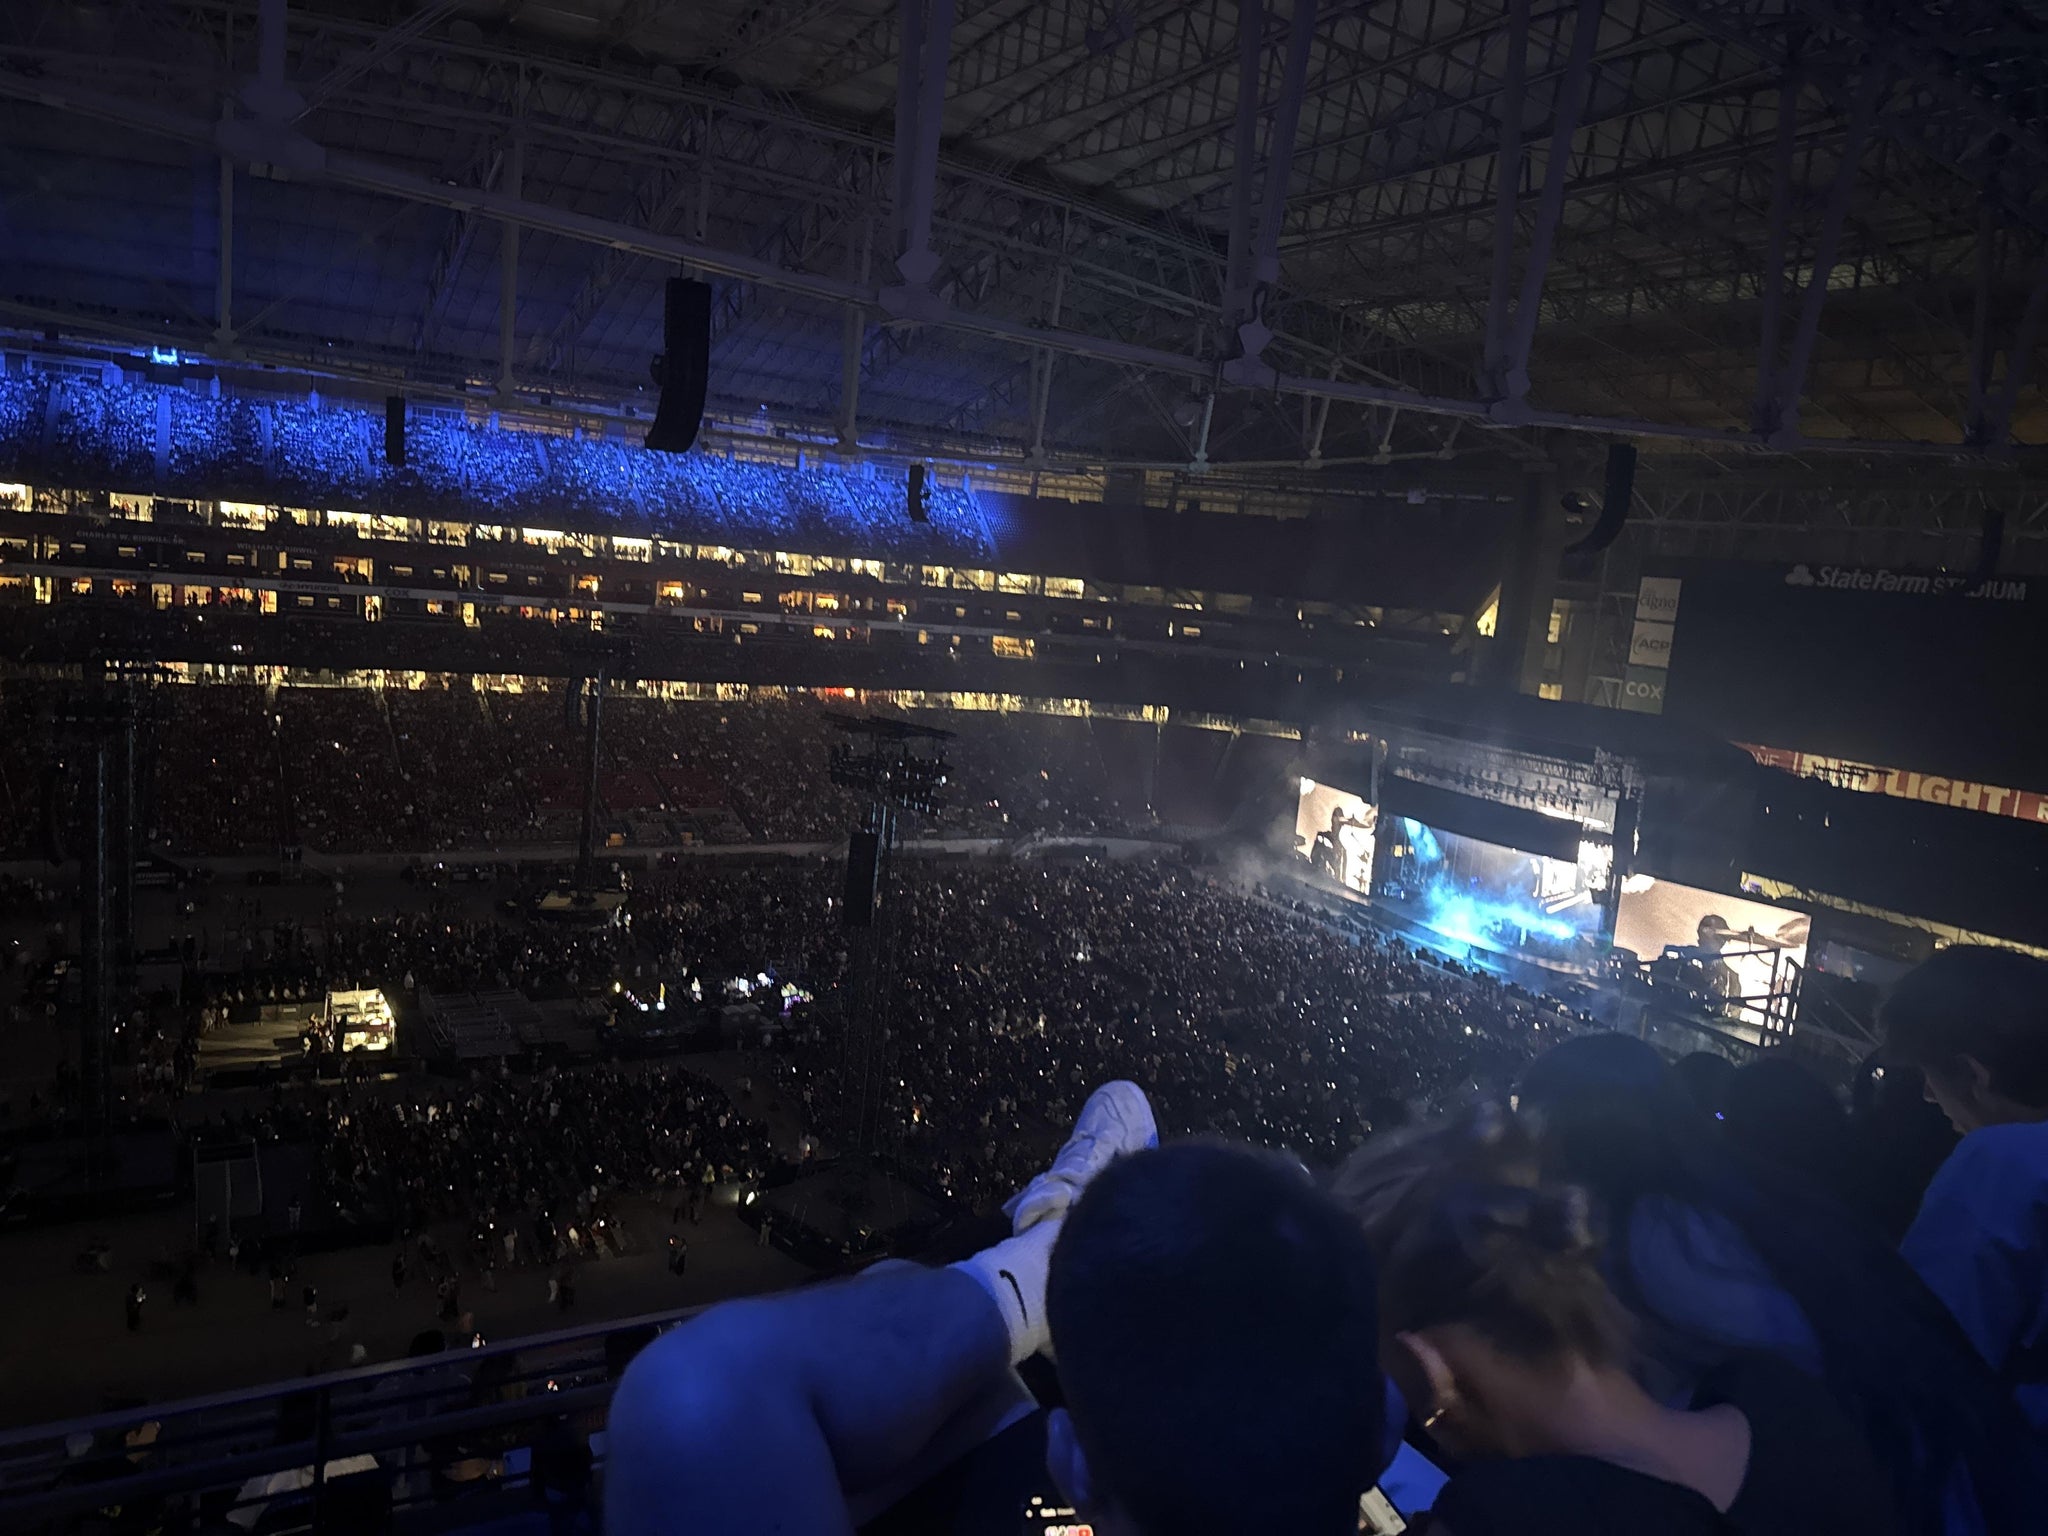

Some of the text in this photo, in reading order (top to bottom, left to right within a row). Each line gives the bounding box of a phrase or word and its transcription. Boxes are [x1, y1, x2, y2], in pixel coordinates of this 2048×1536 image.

[384, 588, 409, 597] COX
[1625, 681, 1663, 699] COX
[1884, 768, 2010, 815] LIGHT
